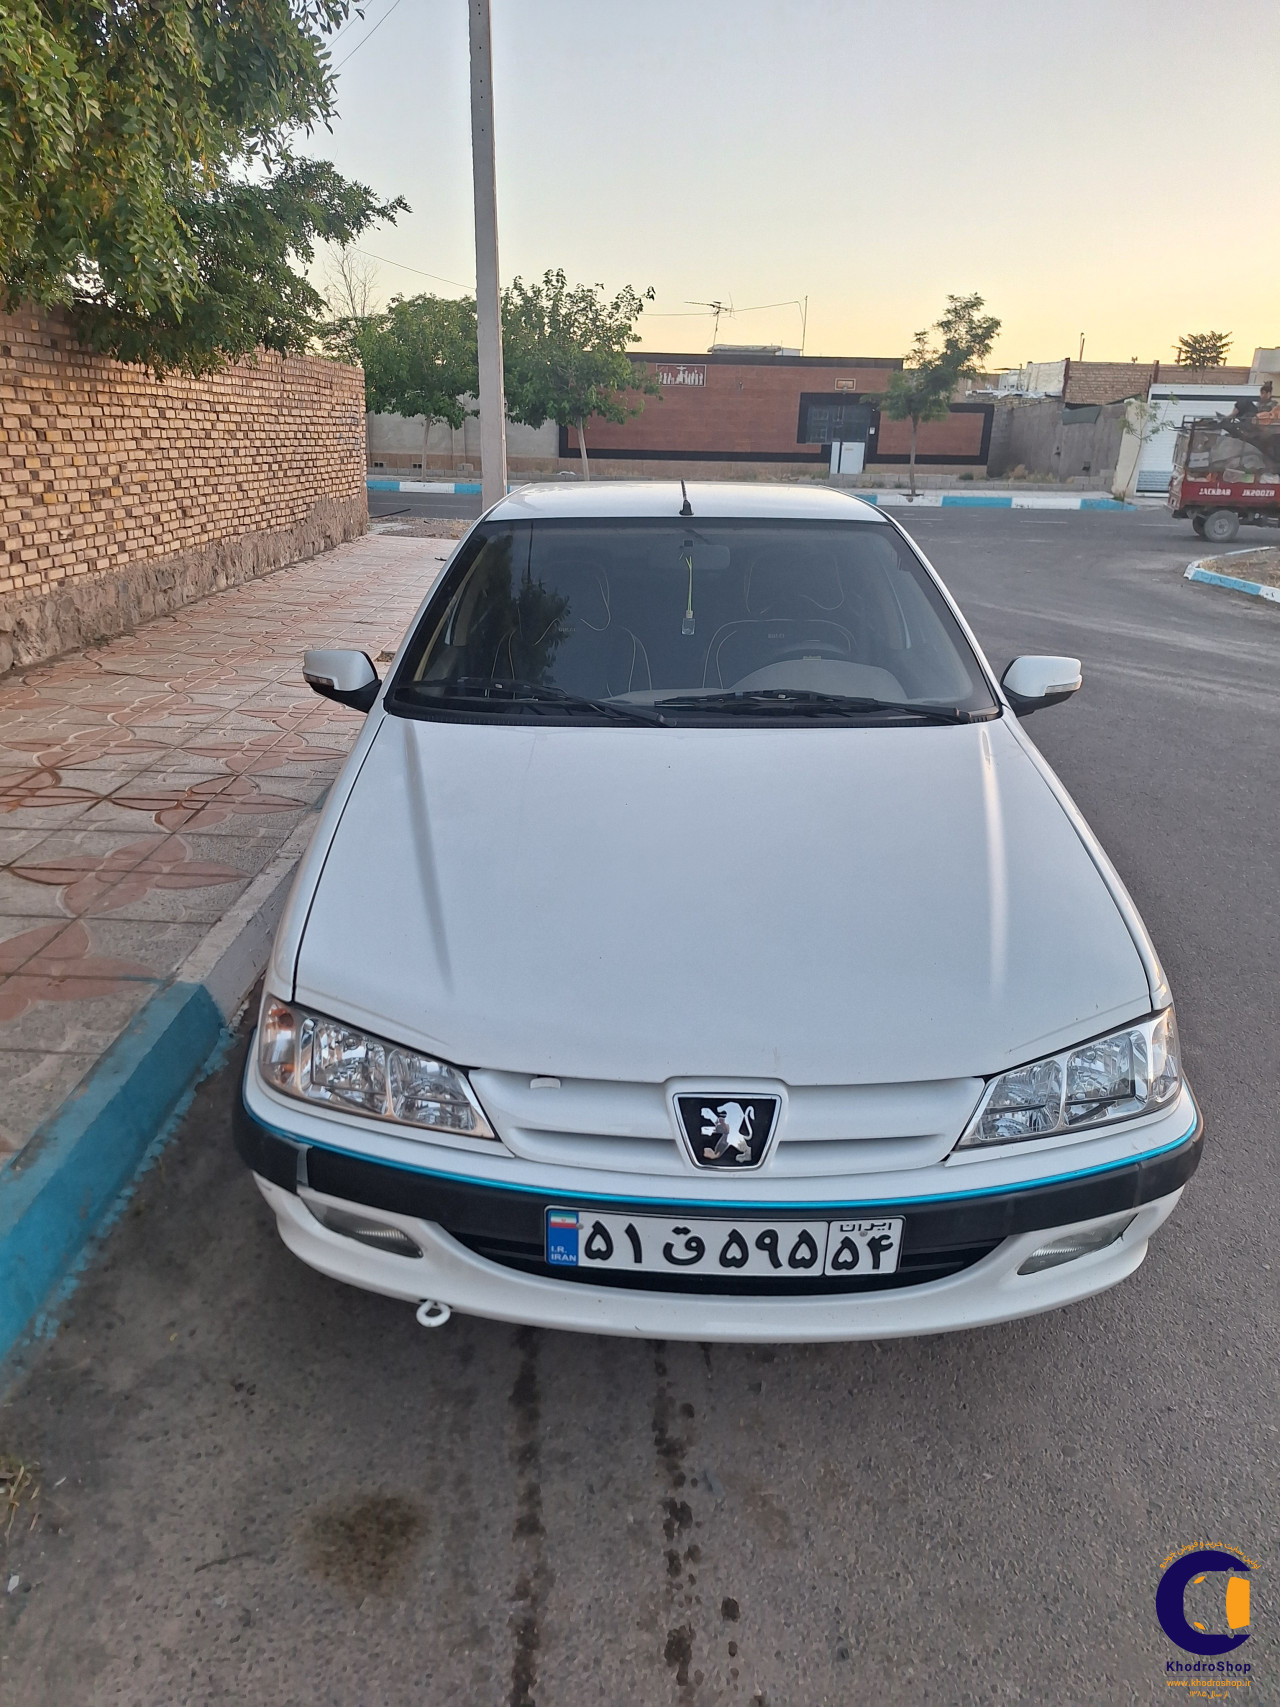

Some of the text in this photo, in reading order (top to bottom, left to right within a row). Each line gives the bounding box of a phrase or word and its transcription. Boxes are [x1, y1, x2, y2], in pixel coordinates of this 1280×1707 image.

[840, 1222, 892, 1233] ایران
[551, 1245, 568, 1254] I.R.
[584, 1220, 819, 1270] ۵۱ ق ۵۹۵
[551, 1253, 577, 1262] IRAN
[831, 1235, 894, 1271] ۵۴
